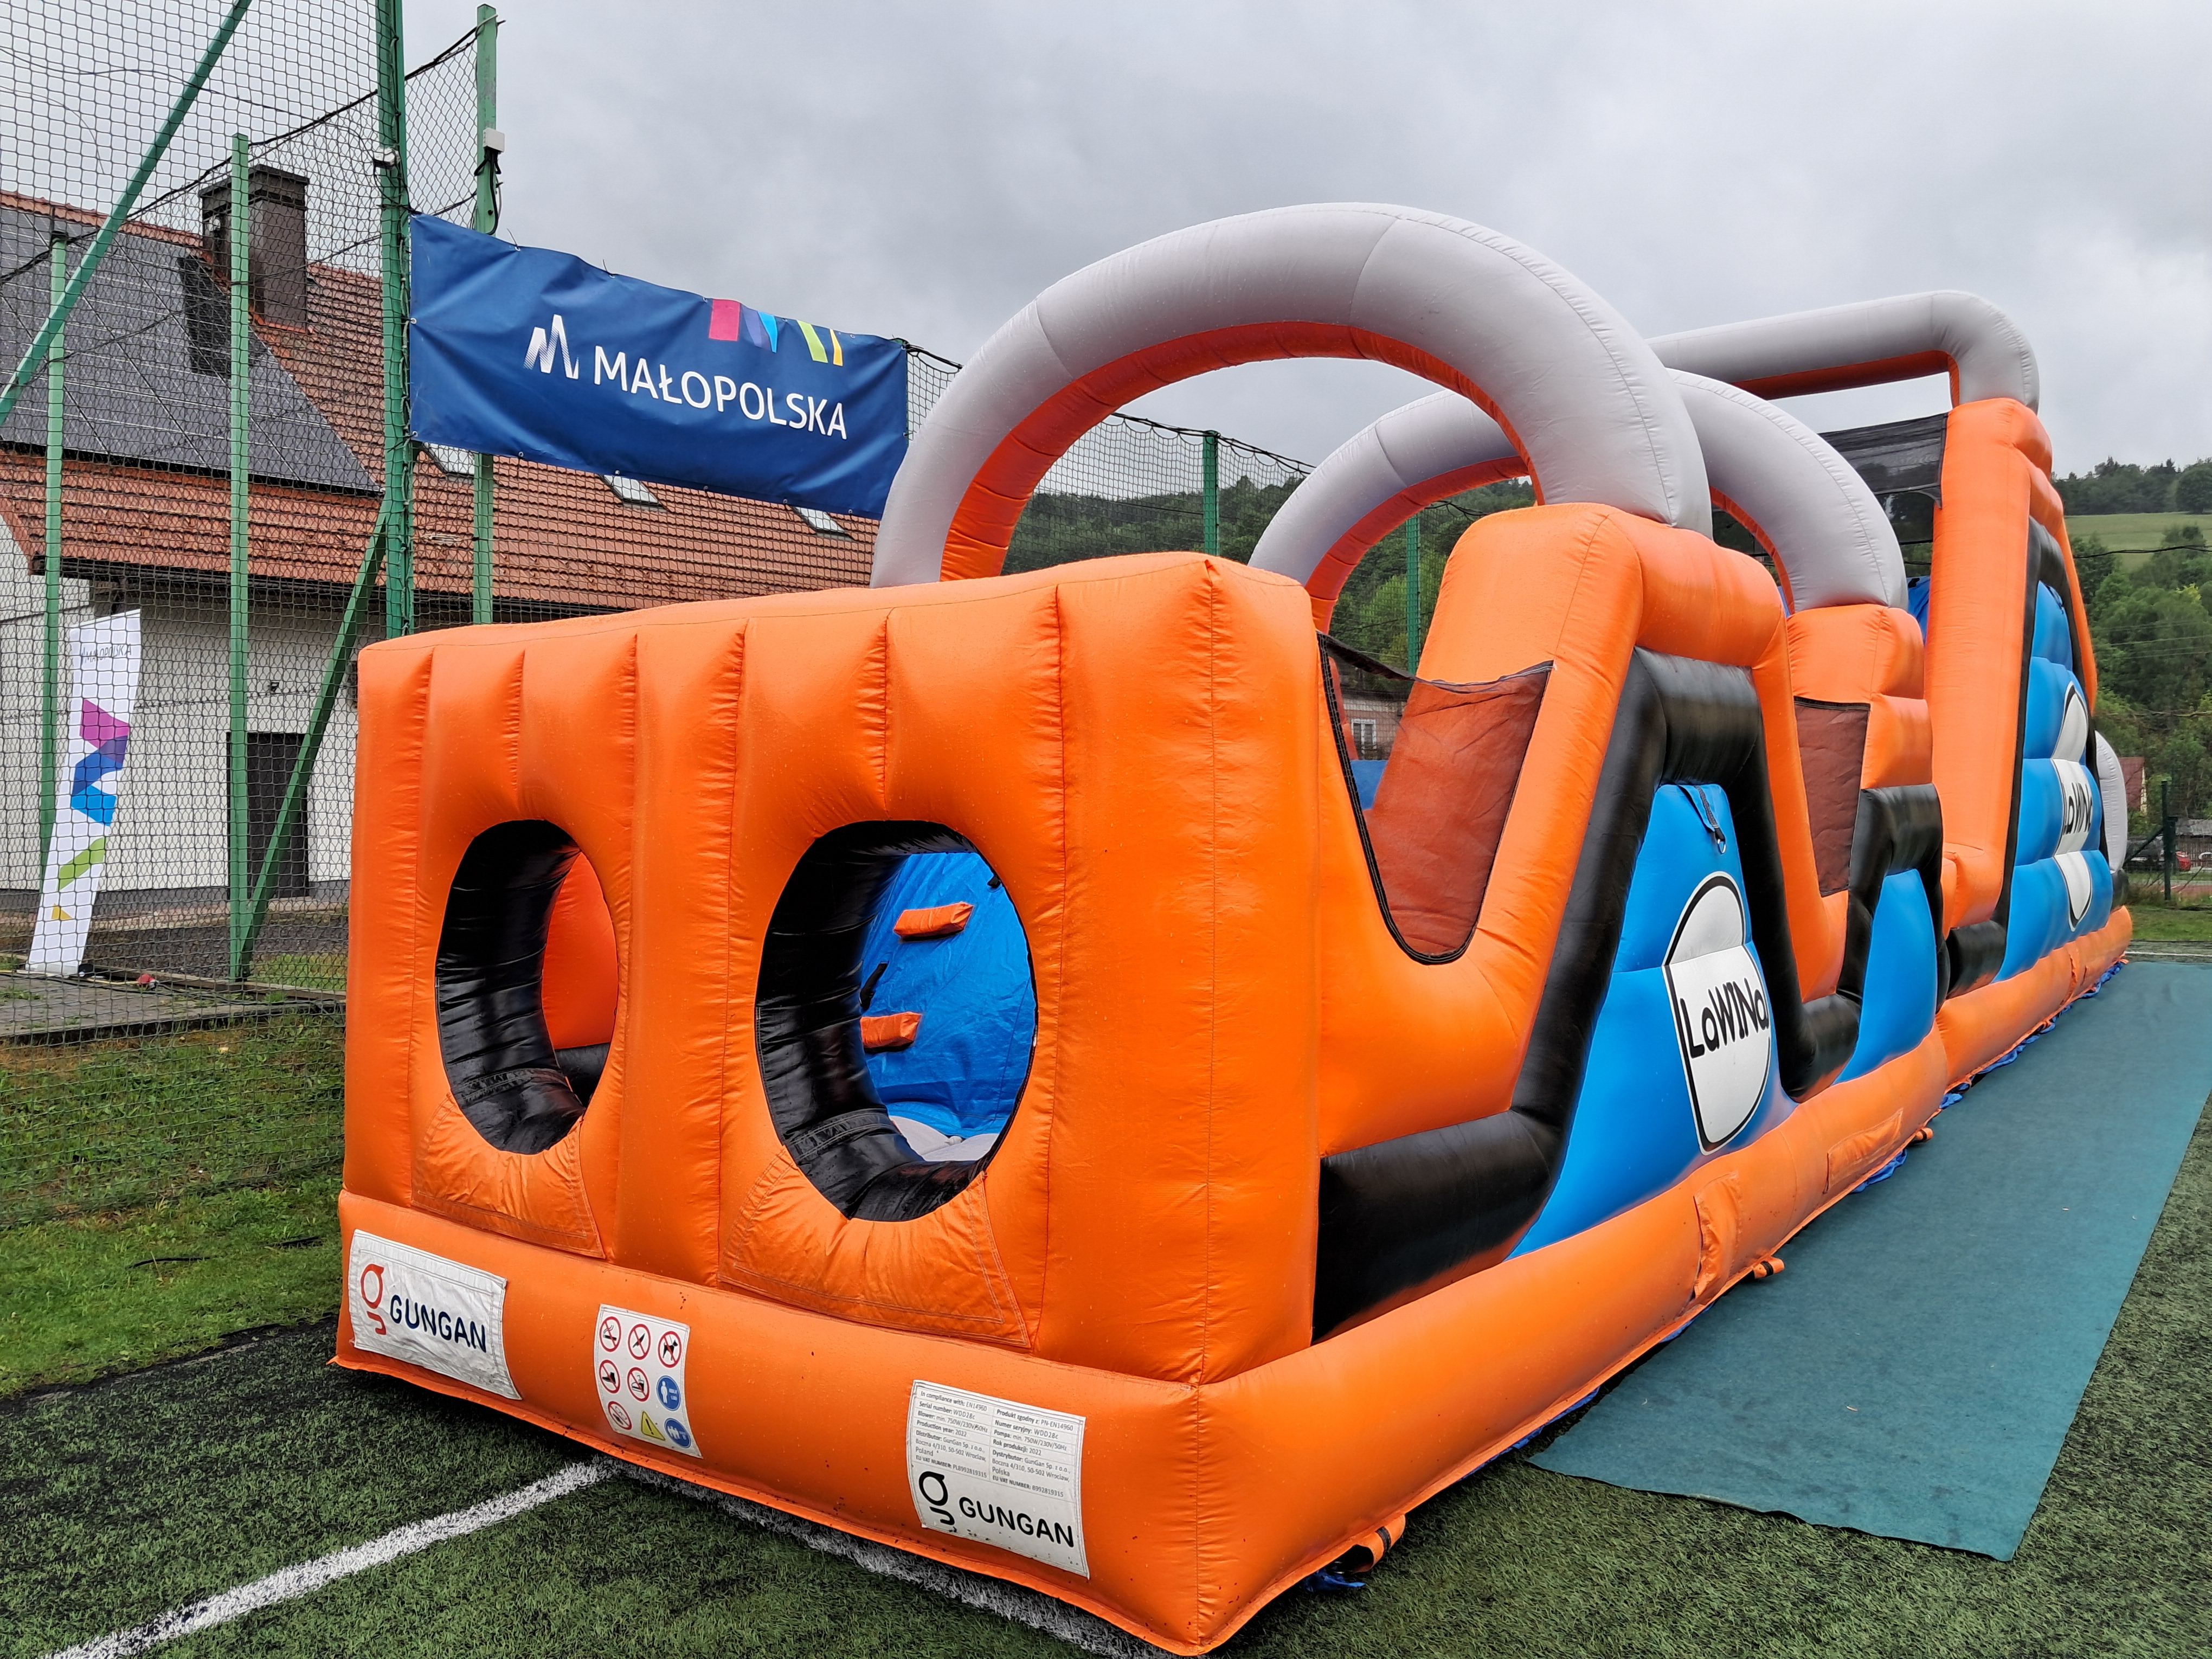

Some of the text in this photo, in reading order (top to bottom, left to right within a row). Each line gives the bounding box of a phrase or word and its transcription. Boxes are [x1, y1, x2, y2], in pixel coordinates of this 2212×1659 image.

[594, 345, 847, 440] MAŁOPOLSKA
[390, 1295, 487, 1353] GUNGAN
[927, 1393, 952, 1403] compliance
[933, 1405, 952, 1413] number:
[918, 1411, 935, 1419] Blower:
[996, 1409, 1015, 1418] Produkt
[1017, 1415, 1034, 1424] zgodny
[917, 1420, 941, 1430] Production
[995, 1420, 1012, 1428] Numer
[1013, 1424, 1032, 1434] seryjny:
[916, 1430, 942, 1441] Distributor:
[943, 1437, 961, 1446] GunGan
[994, 1430, 1012, 1438] Pompa:
[916, 1439, 931, 1447] Boczna
[948, 1447, 964, 1456] 50-502
[916, 1446, 933, 1456] Poland
[1004, 1443, 1028, 1453] produkcji:
[931, 1459, 951, 1468] NUMBER:
[993, 1450, 1023, 1462] Dystrybutor:
[1025, 1458, 1044, 1467] GunGan
[992, 1458, 1008, 1467] Boczna
[1010, 1463, 1026, 1472] 4/310,
[1027, 1468, 1044, 1476] 50-502
[992, 1467, 1009, 1476] Polska
[1009, 1480, 1031, 1489] NUMBER:
[959, 1496, 1074, 1547] GUNGAN
